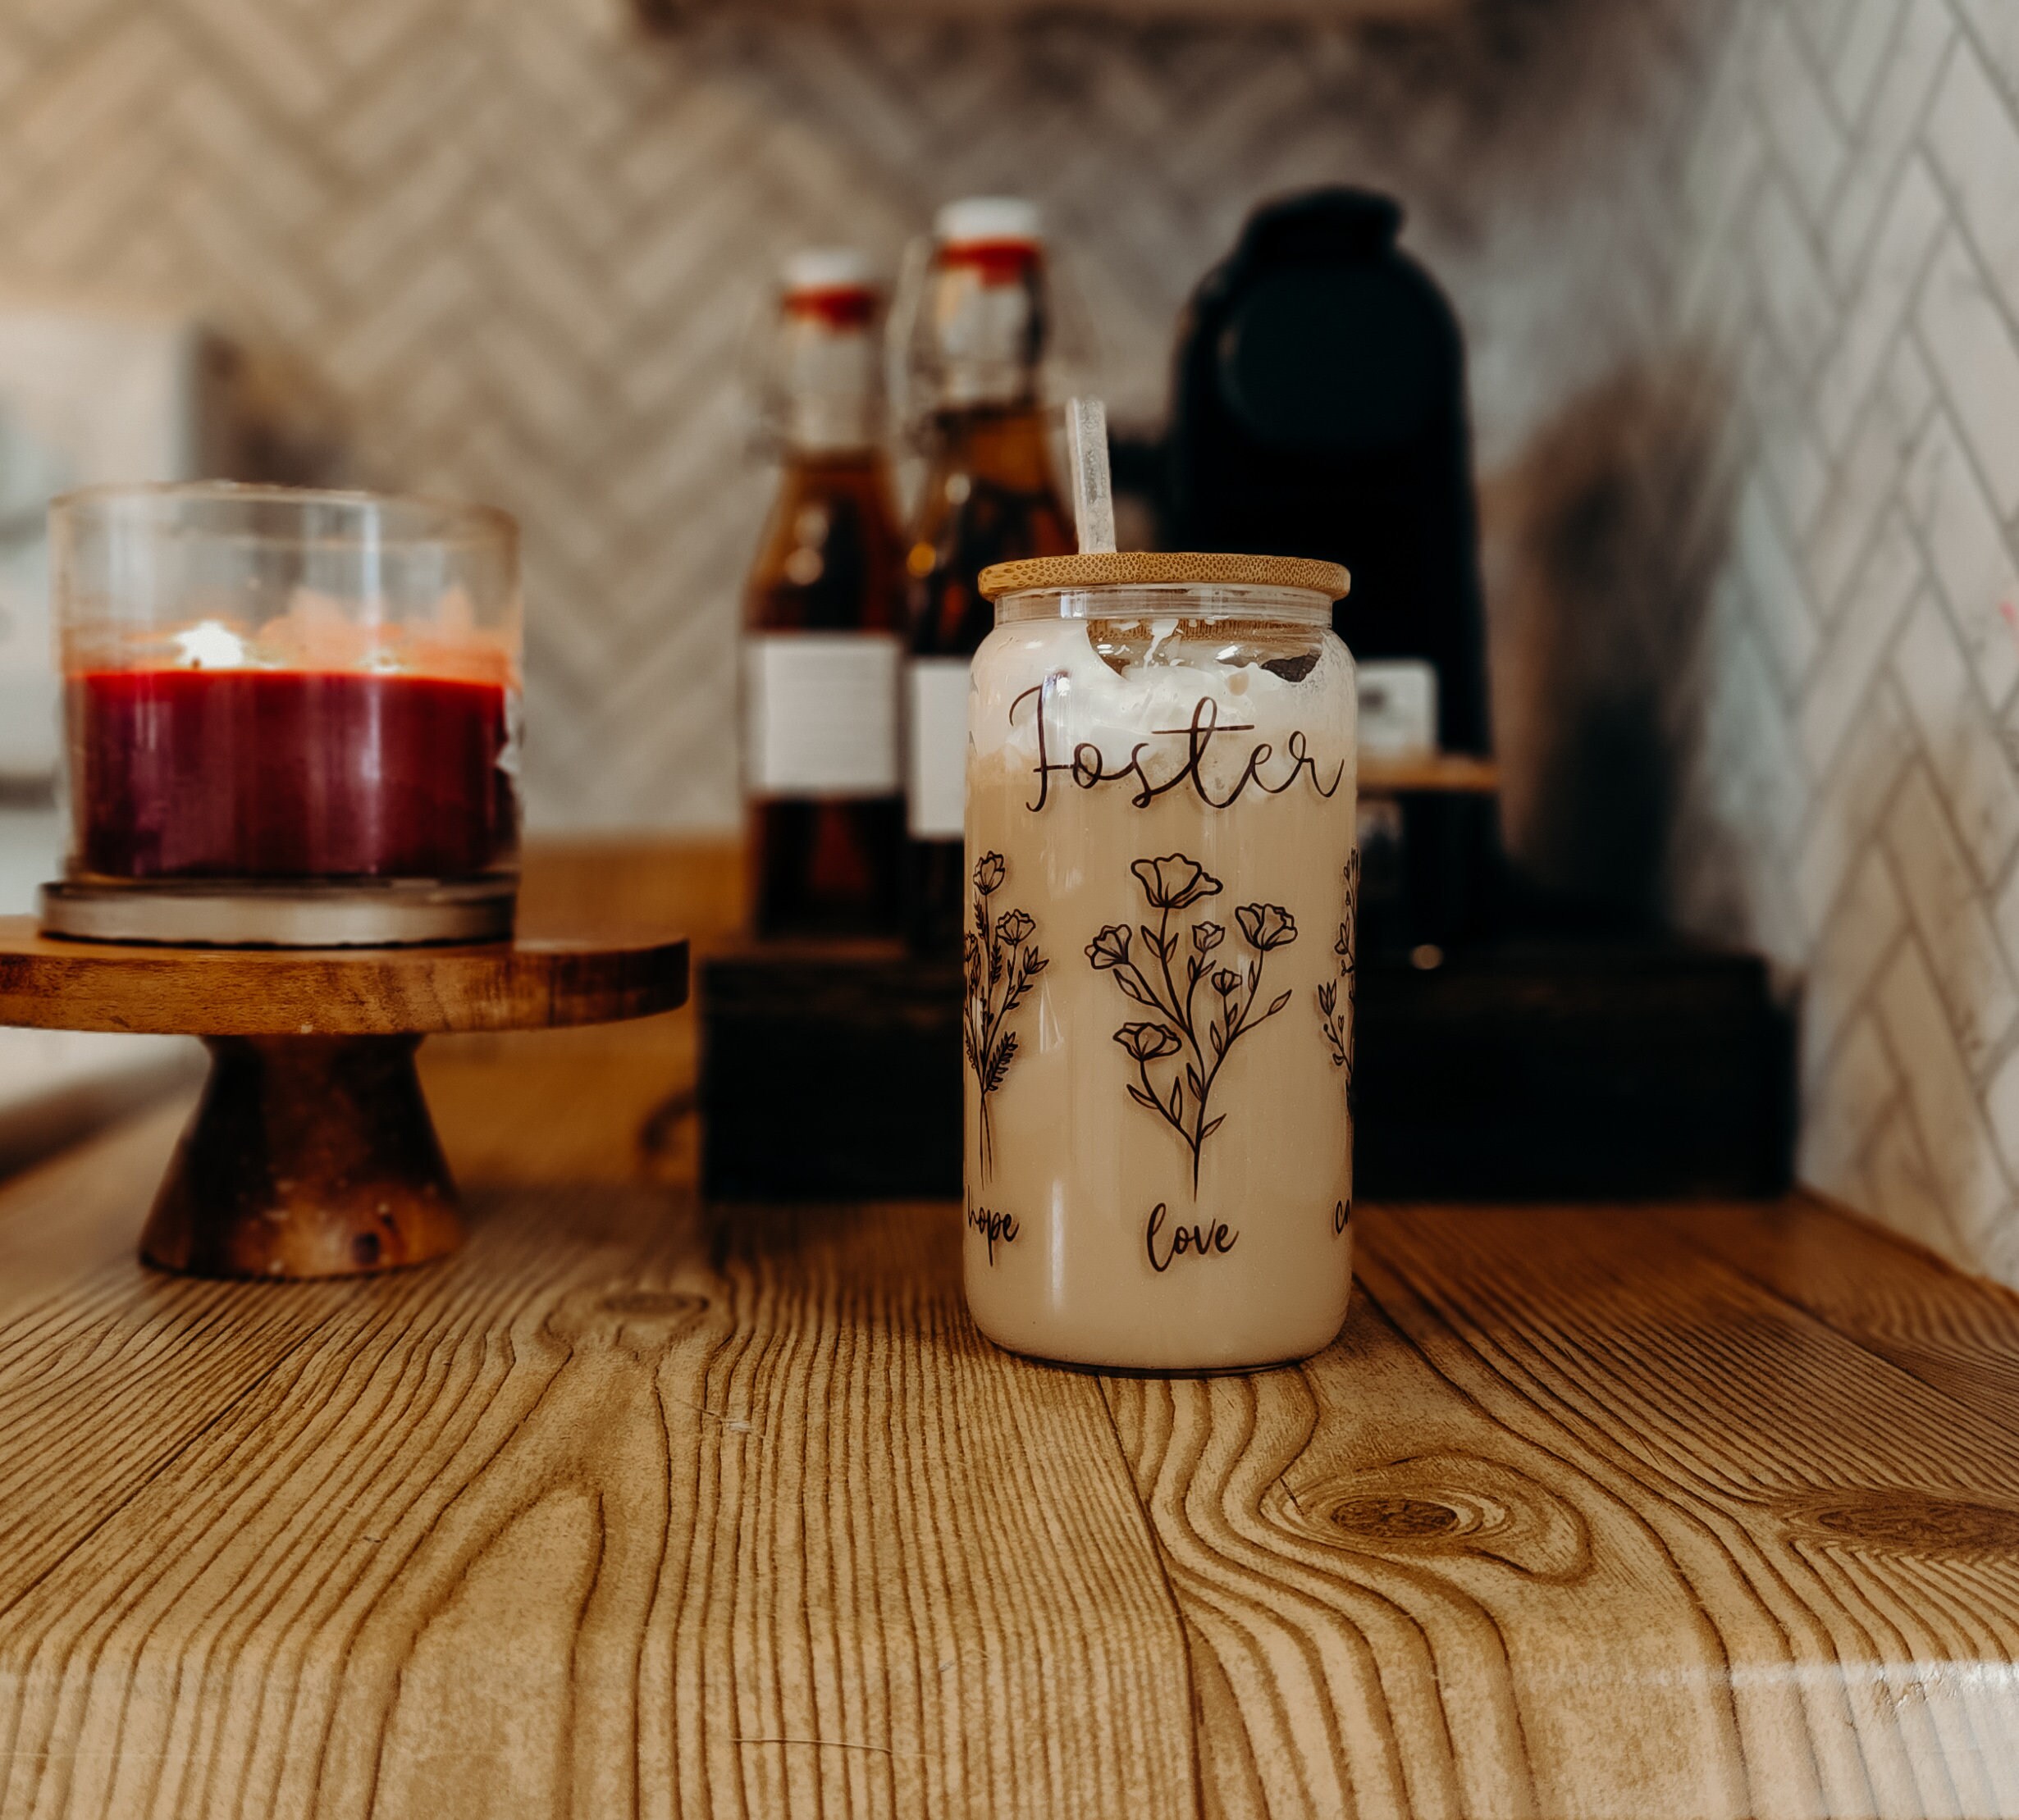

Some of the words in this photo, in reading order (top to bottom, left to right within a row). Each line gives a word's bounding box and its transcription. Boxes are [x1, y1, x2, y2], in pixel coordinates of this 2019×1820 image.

[1008, 669, 1345, 812] Foster
[967, 1184, 1020, 1267] hope
[1148, 1202, 1239, 1272] love
